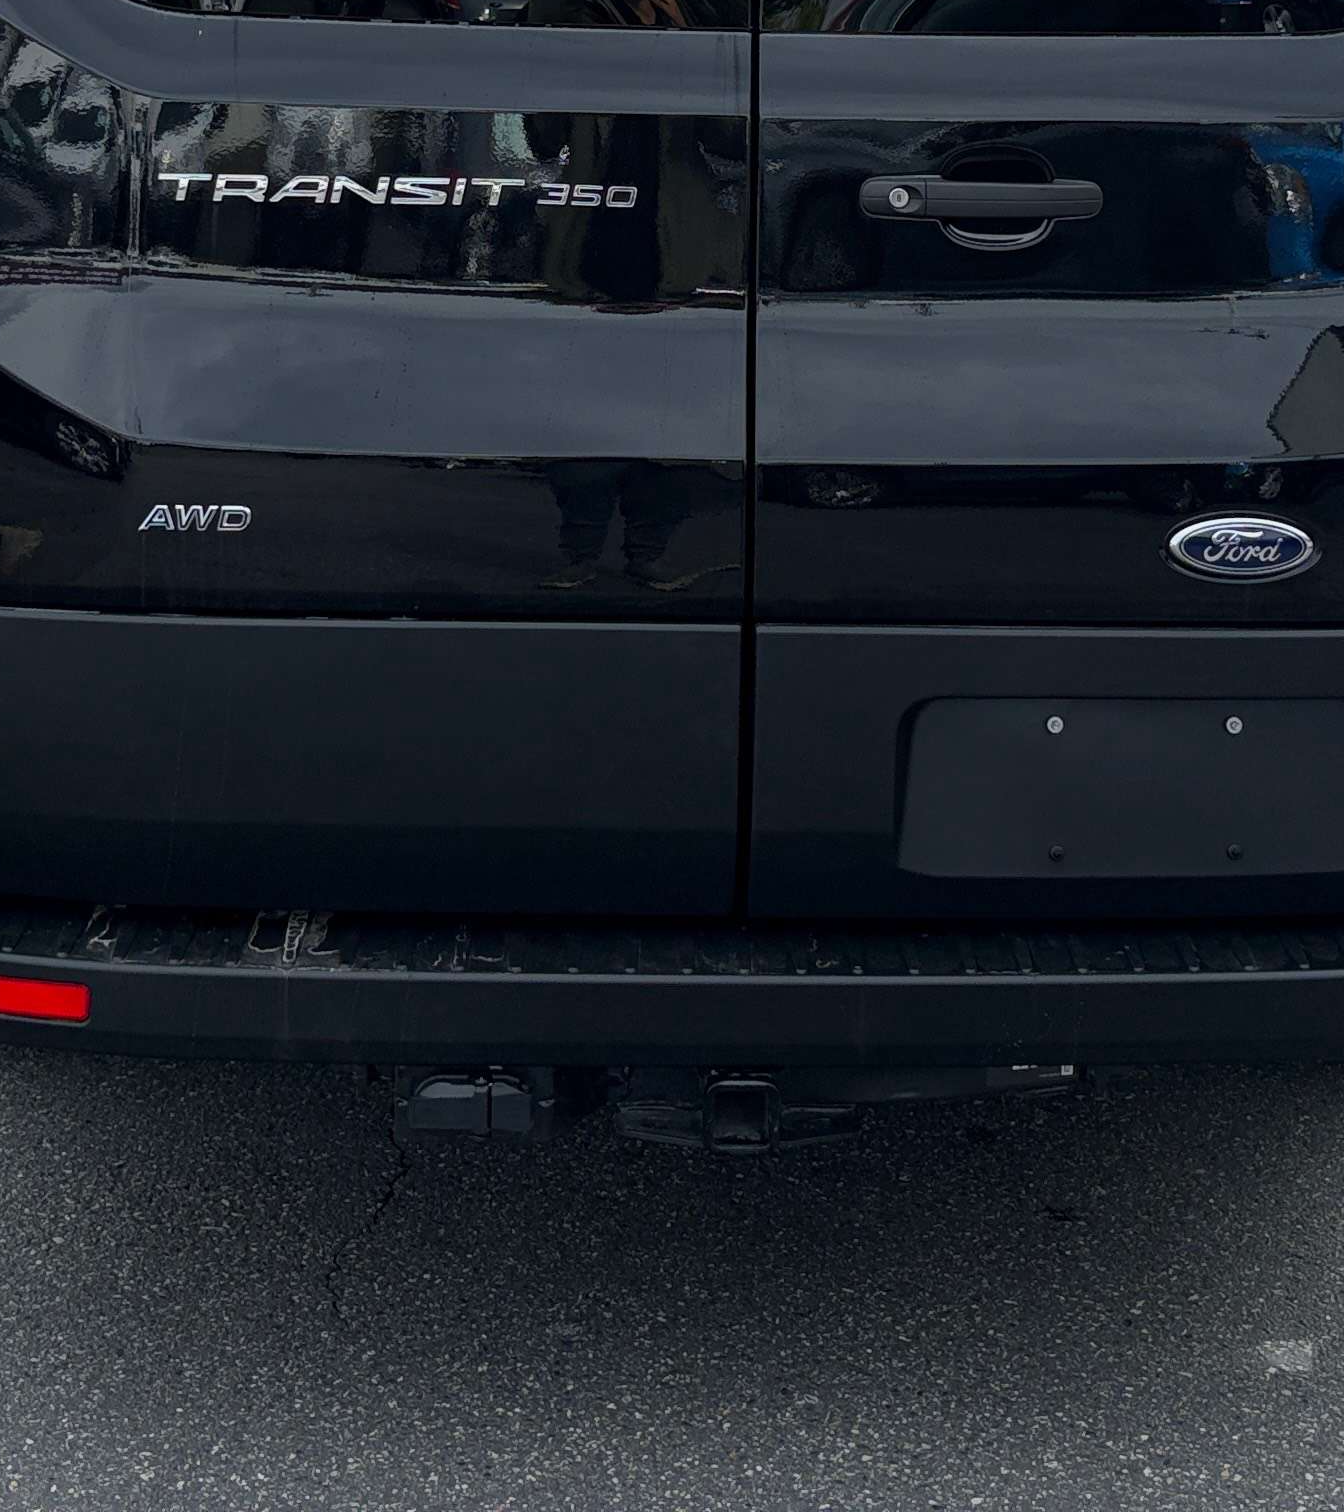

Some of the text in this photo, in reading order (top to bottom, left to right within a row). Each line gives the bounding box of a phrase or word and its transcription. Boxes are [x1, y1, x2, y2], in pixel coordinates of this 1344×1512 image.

[158, 173, 638, 208] TRANSIT 350
[138, 504, 252, 531] AWD
[1203, 529, 1284, 562] Ford
